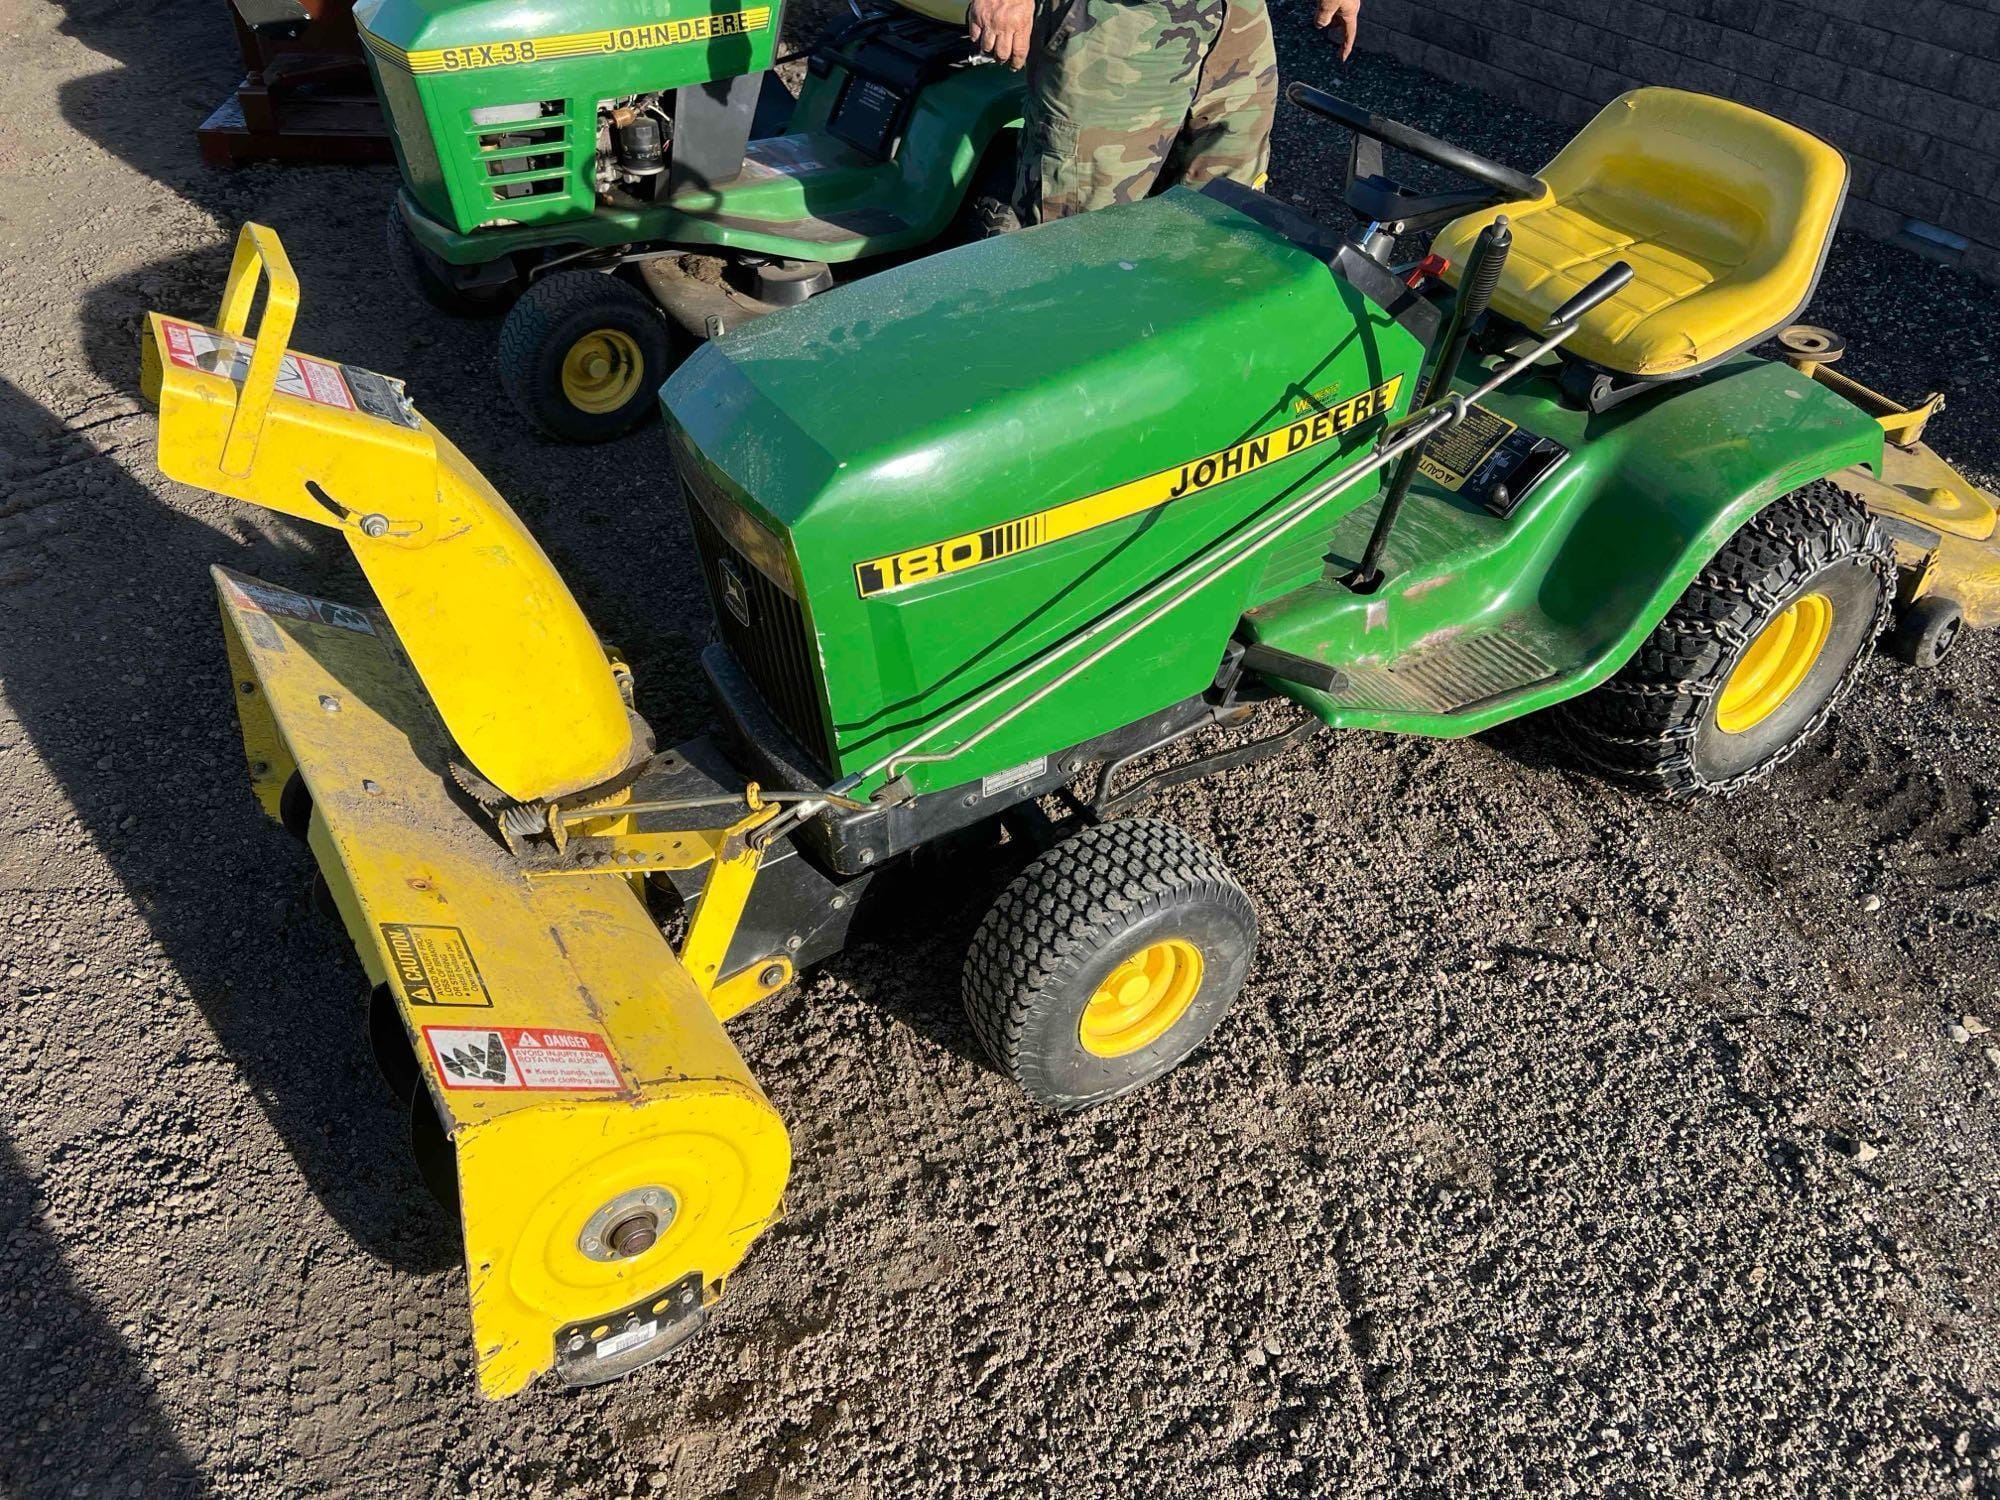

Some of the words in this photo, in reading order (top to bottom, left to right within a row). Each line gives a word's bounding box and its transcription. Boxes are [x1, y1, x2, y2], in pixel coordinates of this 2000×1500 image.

[603, 24, 670, 52] JOHN
[678, 12, 750, 39] DEERE
[442, 46, 493, 70] STX
[501, 41, 535, 63] 38
[1170, 438, 1270, 498] JOHN
[1287, 383, 1391, 454] DEERE
[1417, 460, 1445, 480] CAUT
[873, 534, 983, 592] 180
[388, 931, 424, 981] CAUTION
[425, 938, 442, 967] BRAKING
[437, 969, 446, 978] OF
[439, 954, 458, 986] STEERING
[431, 976, 444, 996] AVOID
[441, 978, 454, 996] LOSS
[453, 986, 463, 997] OR
[543, 1034, 591, 1049] DANGER
[516, 1049, 544, 1057] AVOID
[535, 1067, 559, 1076] Keep
[558, 1076, 592, 1086] clothing
